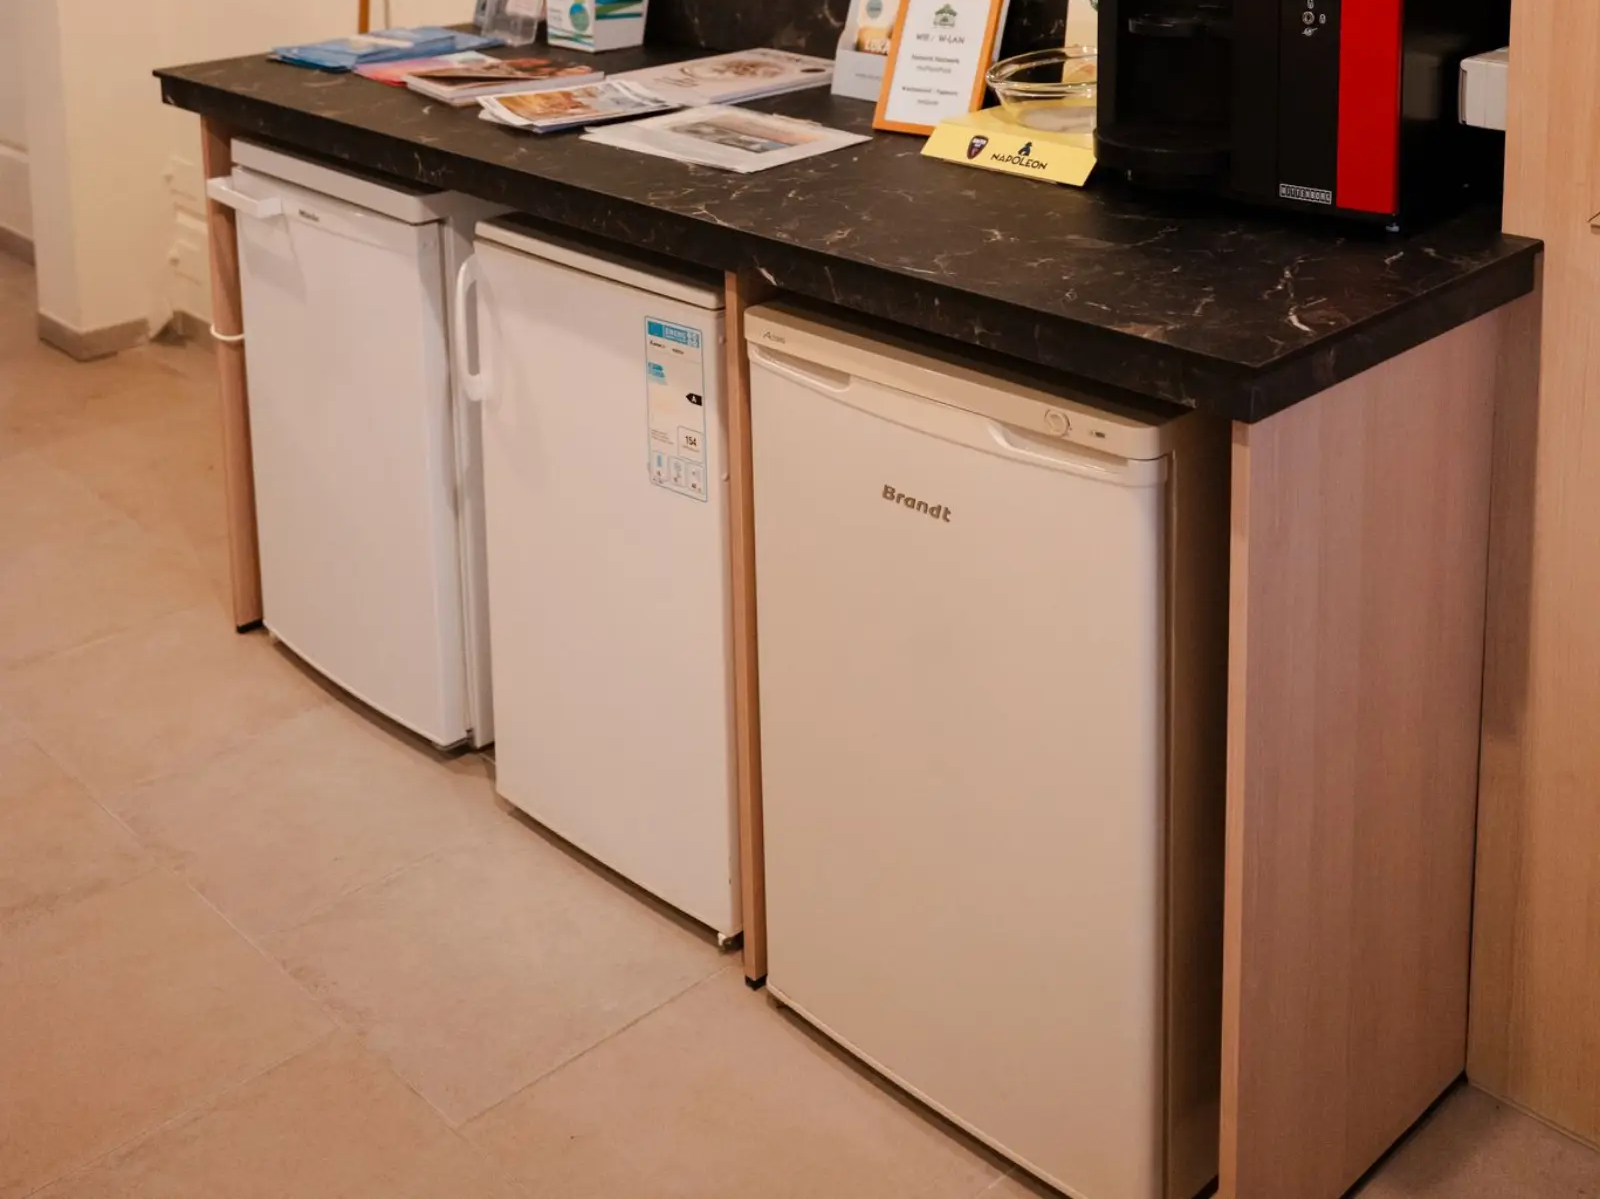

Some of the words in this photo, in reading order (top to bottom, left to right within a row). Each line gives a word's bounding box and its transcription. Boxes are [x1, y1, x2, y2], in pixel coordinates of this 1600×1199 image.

[991, 153, 1048, 170] NAPOLEON
[685, 435, 698, 447] 154
[882, 484, 951, 522] Brandt
